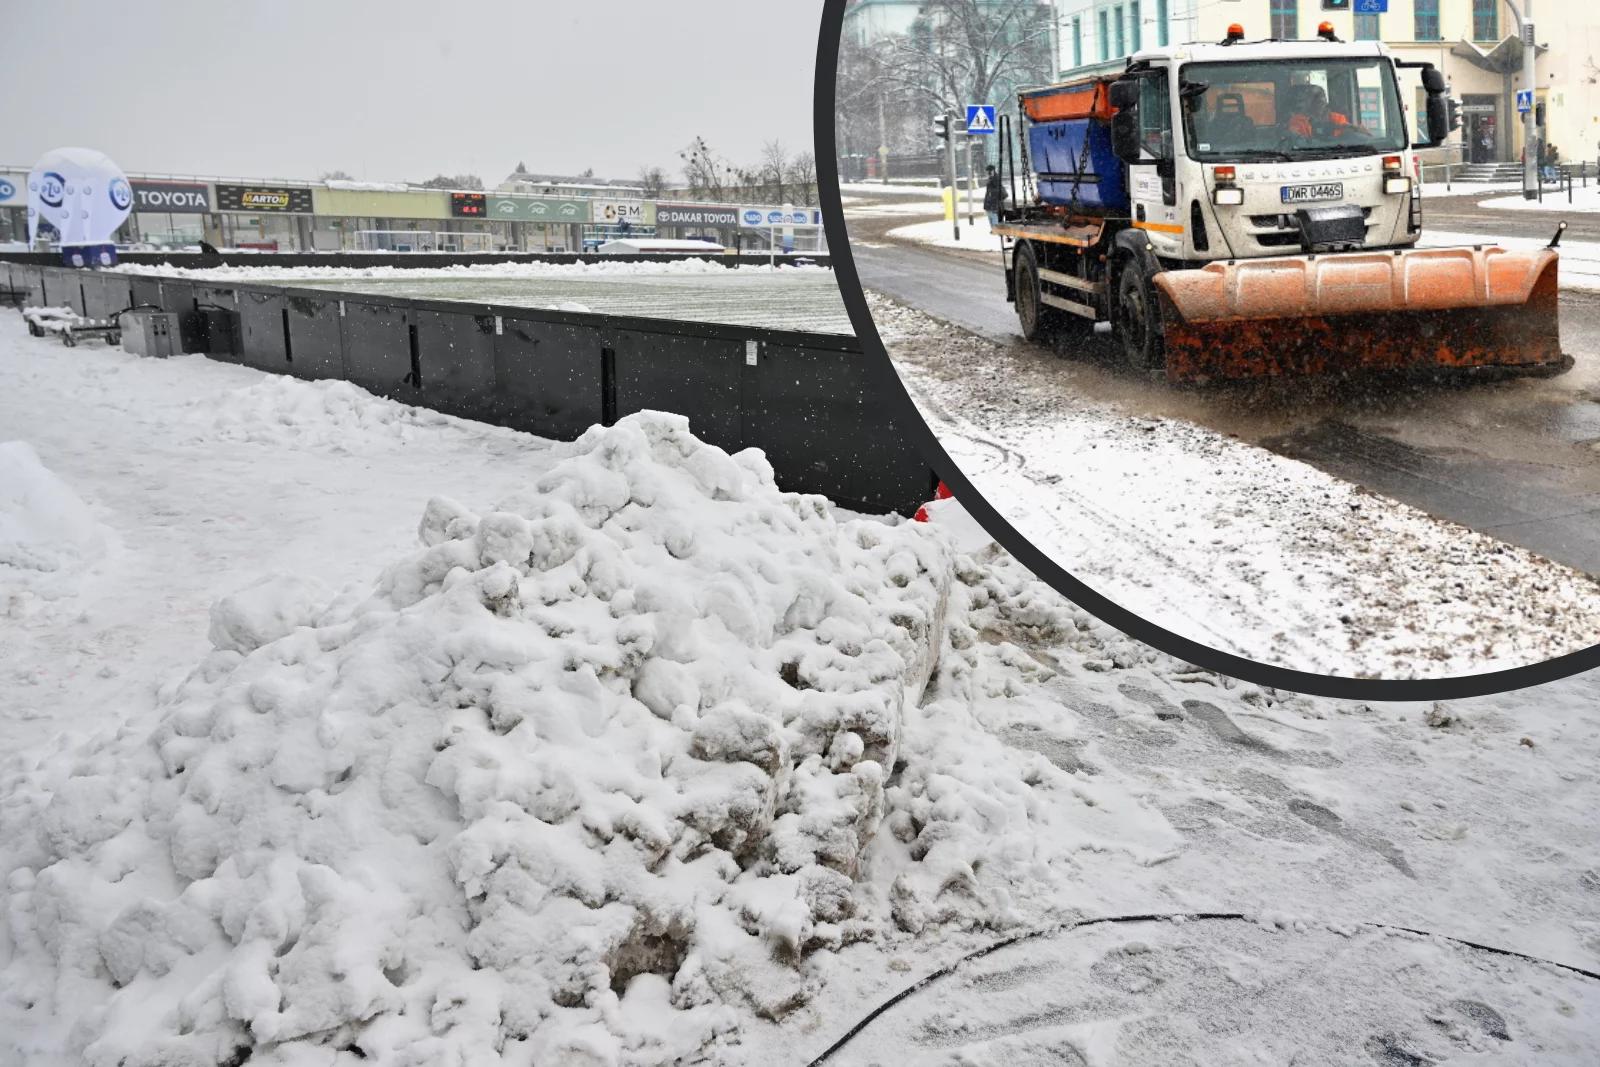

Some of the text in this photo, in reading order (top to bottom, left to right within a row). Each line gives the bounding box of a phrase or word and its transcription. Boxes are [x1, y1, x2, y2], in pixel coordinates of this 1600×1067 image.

[138, 190, 207, 207] TOYOTA
[1287, 184, 1341, 200] DWR 0446S
[241, 194, 289, 205] MARTOM
[671, 211, 736, 224] DAKAR TOYOTA
